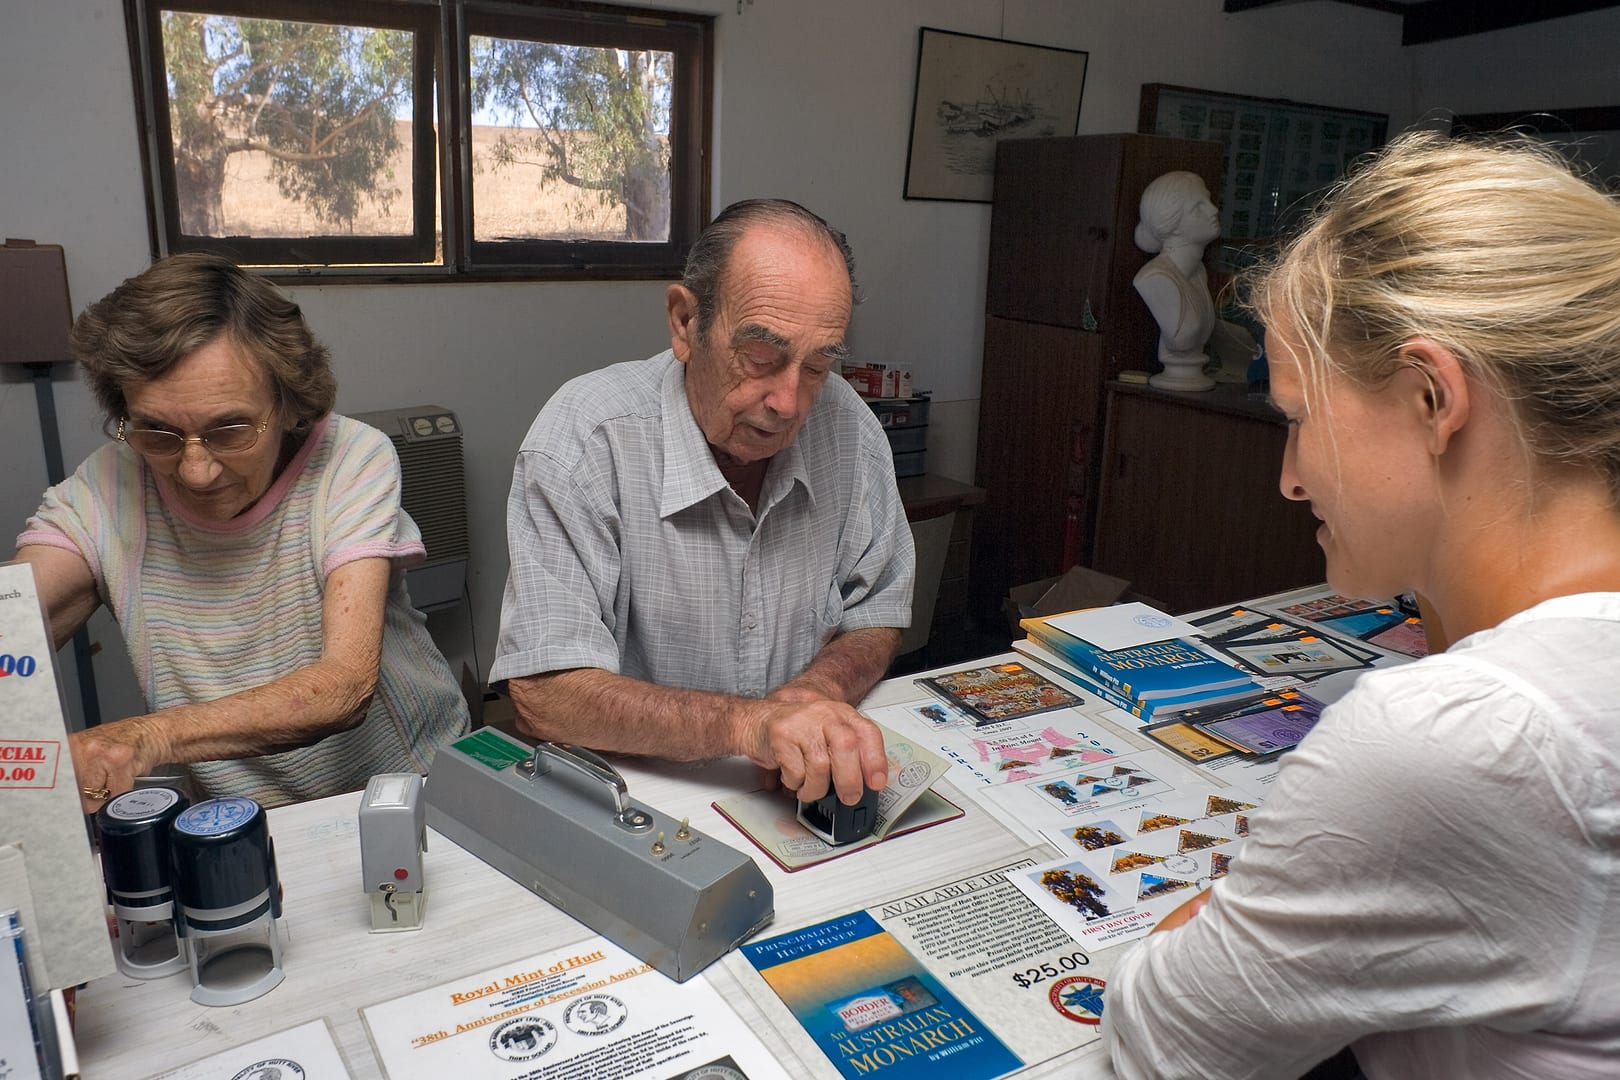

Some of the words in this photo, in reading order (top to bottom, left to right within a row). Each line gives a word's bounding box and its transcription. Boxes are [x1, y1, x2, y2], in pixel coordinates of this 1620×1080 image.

[1105, 651, 1208, 671] MONARCH
[881, 879, 983, 918] AVAILABLE
[917, 904, 950, 919] Principality
[973, 892, 988, 900] River
[908, 911, 949, 928] Northampton
[972, 898, 989, 906] Office
[990, 907, 1022, 921] Principality
[1082, 925, 1106, 936] FIRST
[1106, 920, 1122, 929] DAY
[1123, 911, 1153, 923] COVER
[755, 923, 840, 955] PRINCIPALITY
[842, 918, 858, 929] OF
[776, 942, 814, 960] HUTT
[817, 930, 856, 947] RIVER
[958, 932, 985, 944] Australia
[988, 942, 1021, 957] Principality
[451, 981, 499, 1004] Royal
[503, 969, 545, 988] Mint
[548, 960, 565, 973] of
[568, 950, 605, 968] Hutt
[949, 970, 962, 978] Dip
[1012, 952, 1089, 989] $25.00
[455, 1003, 530, 1034] Anniversary
[533, 996, 546, 1008] of
[547, 980, 606, 1002] Secession
[607, 967, 638, 985] April
[640, 962, 657, 974] 20
[840, 997, 889, 1020] BORDER
[829, 1029, 847, 1042] An
[838, 1006, 953, 1058] AUSTRALIAN
[848, 1017, 976, 1077] MONARCH
[928, 1053, 940, 1063] by
[939, 1040, 970, 1057] William
[969, 1035, 984, 1048] Pitt
